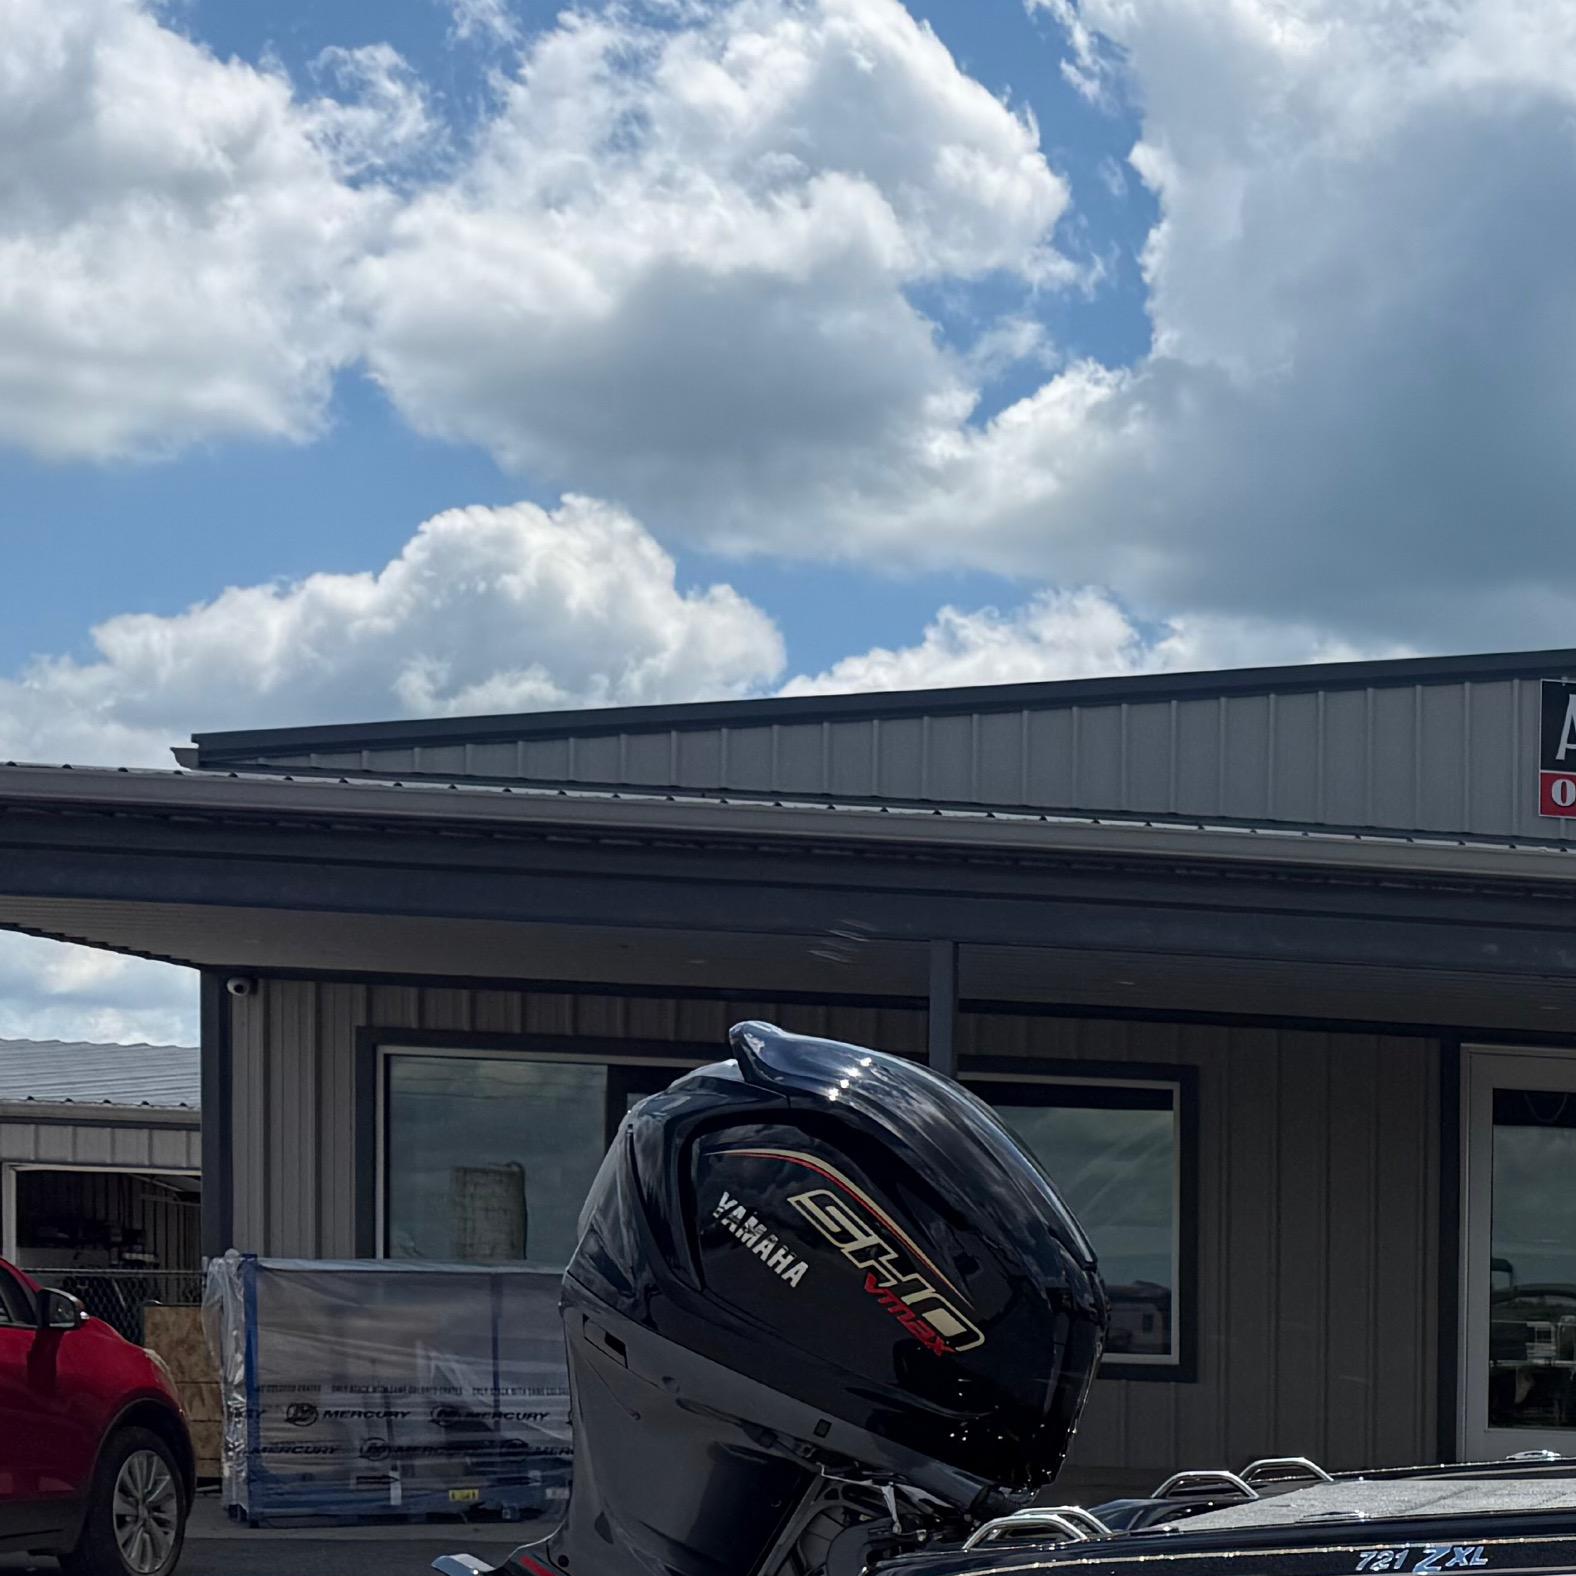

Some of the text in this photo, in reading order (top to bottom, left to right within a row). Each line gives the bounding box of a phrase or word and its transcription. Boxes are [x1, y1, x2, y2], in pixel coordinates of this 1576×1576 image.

[712, 1191, 809, 1288] YAMAHA
[787, 1189, 986, 1351] SHO
[322, 1410, 411, 1419] MERCURY
[1355, 1549, 1409, 1571] 721
